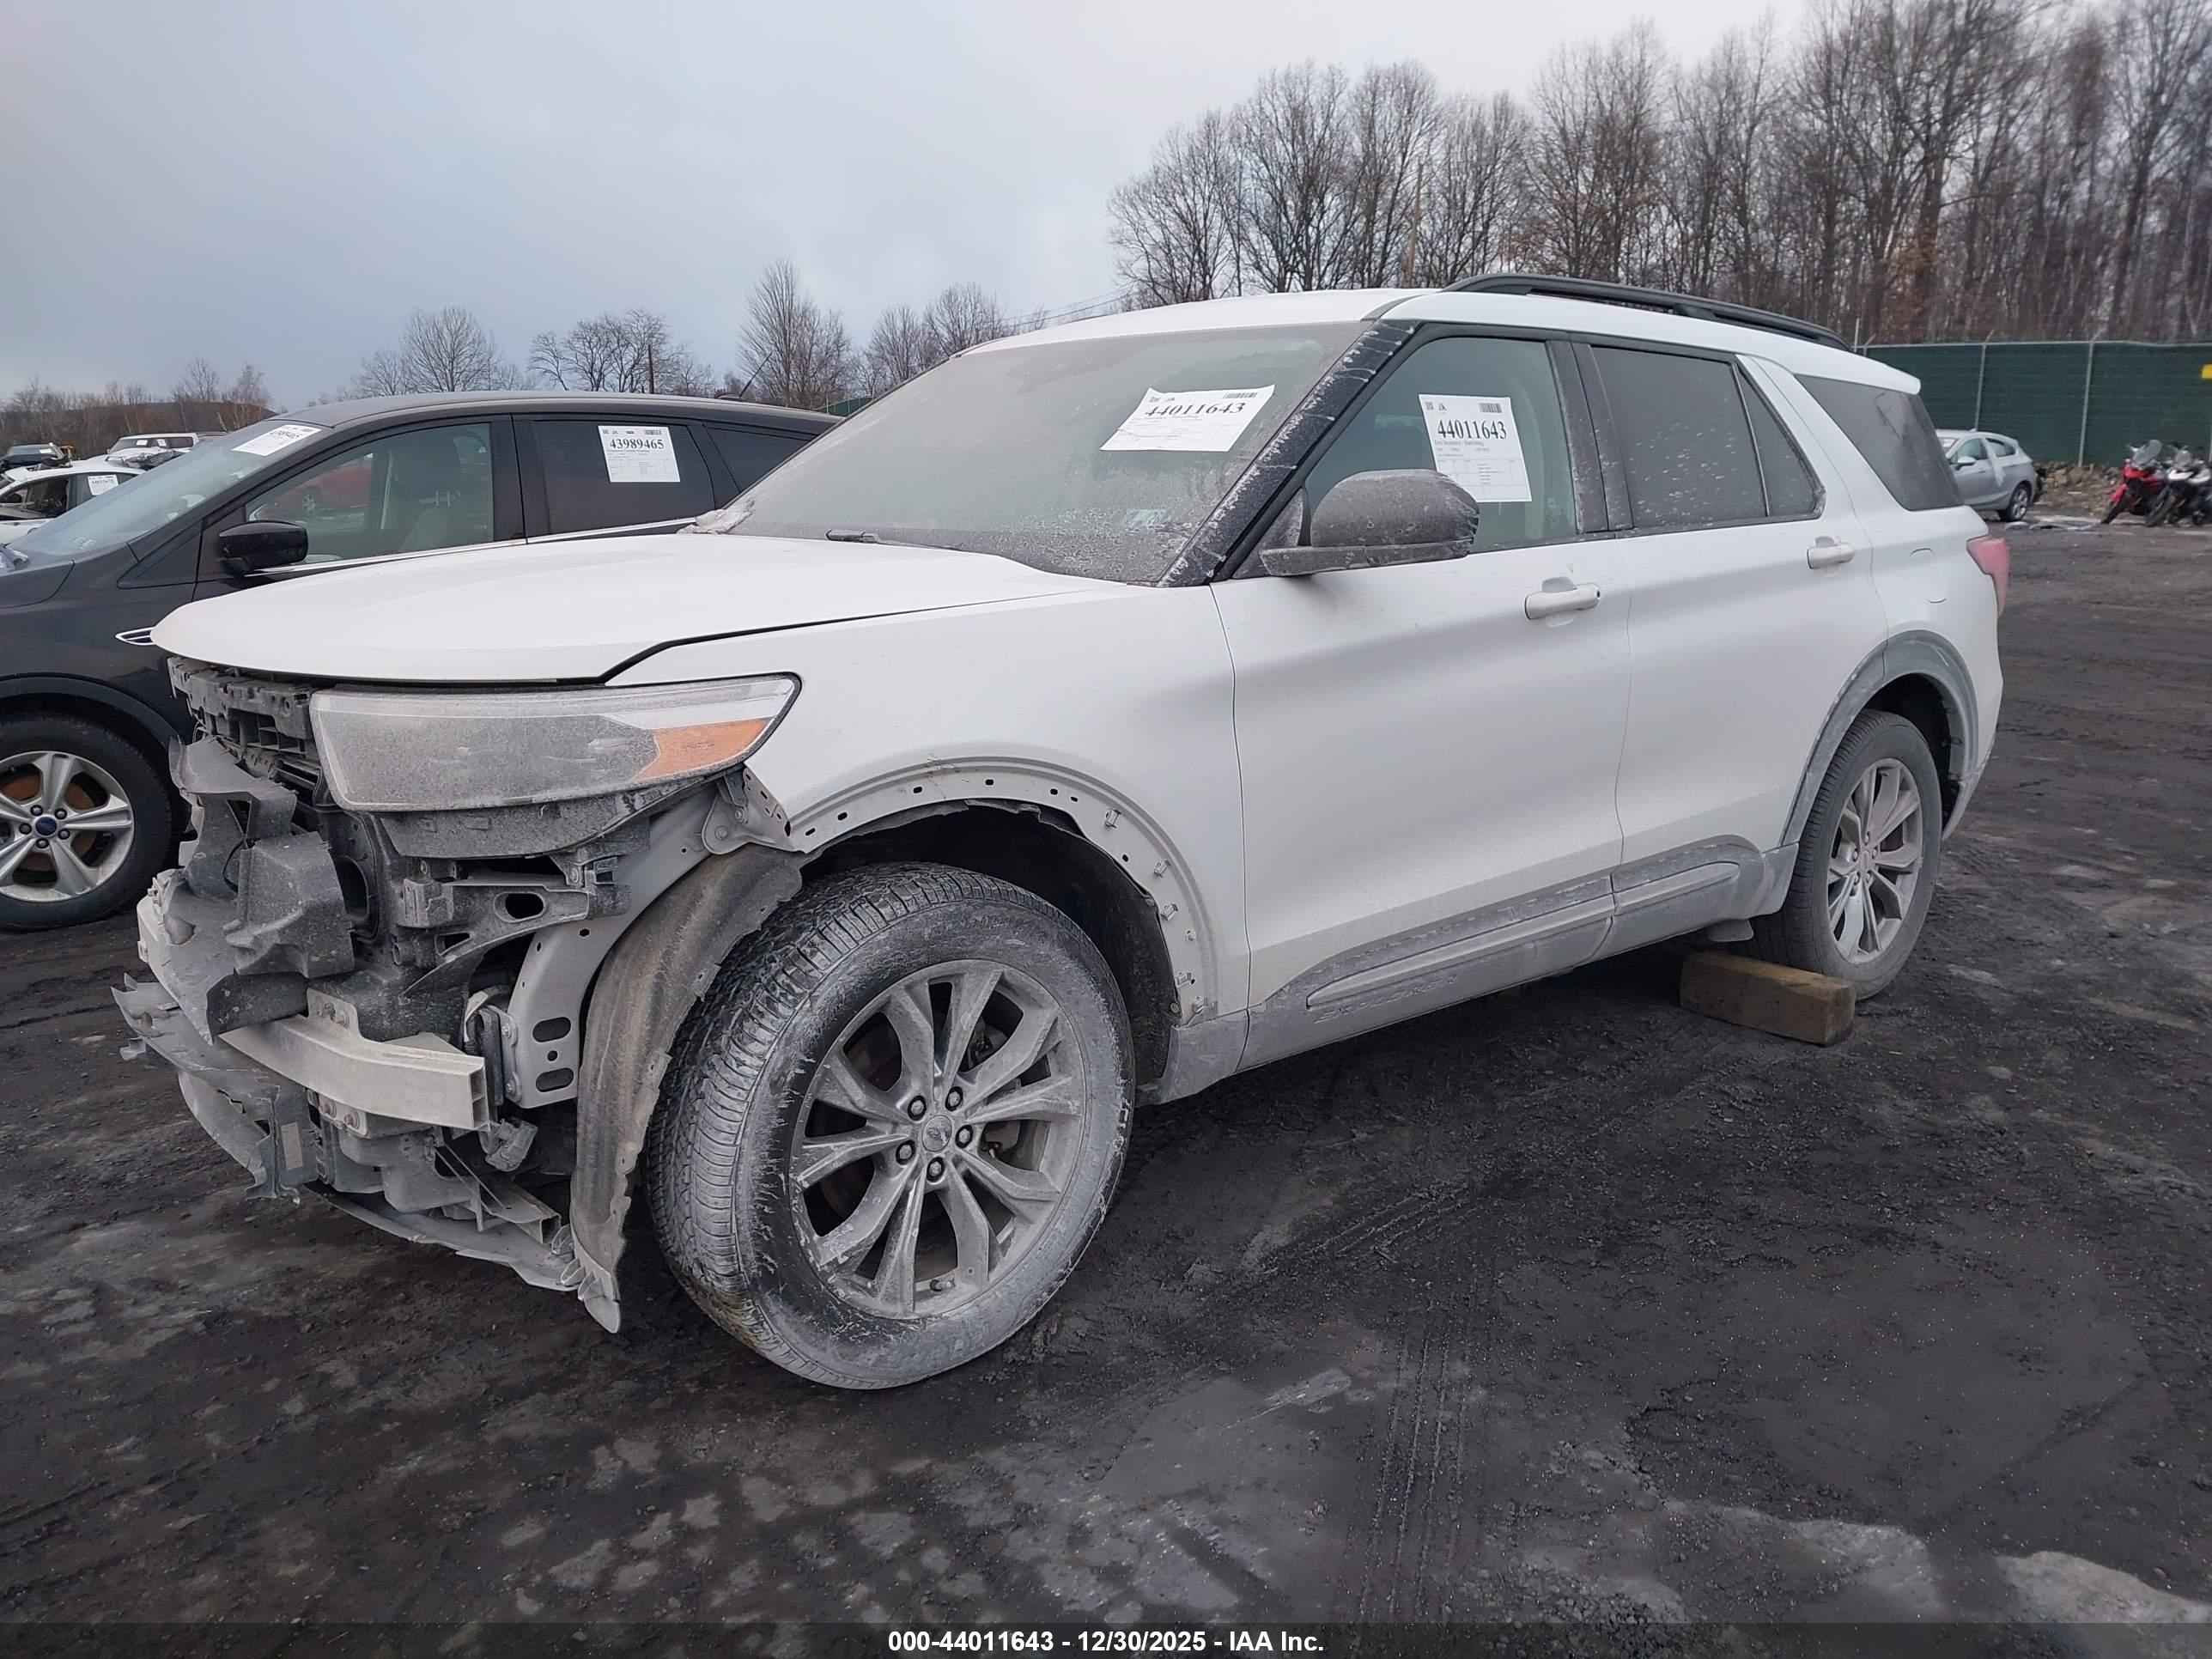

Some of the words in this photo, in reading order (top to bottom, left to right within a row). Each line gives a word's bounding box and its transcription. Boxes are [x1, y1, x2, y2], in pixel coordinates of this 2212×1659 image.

[1145, 402, 1246, 416] 44011643
[1437, 419, 1507, 440] 44011643
[610, 438, 665, 449] 43989465
